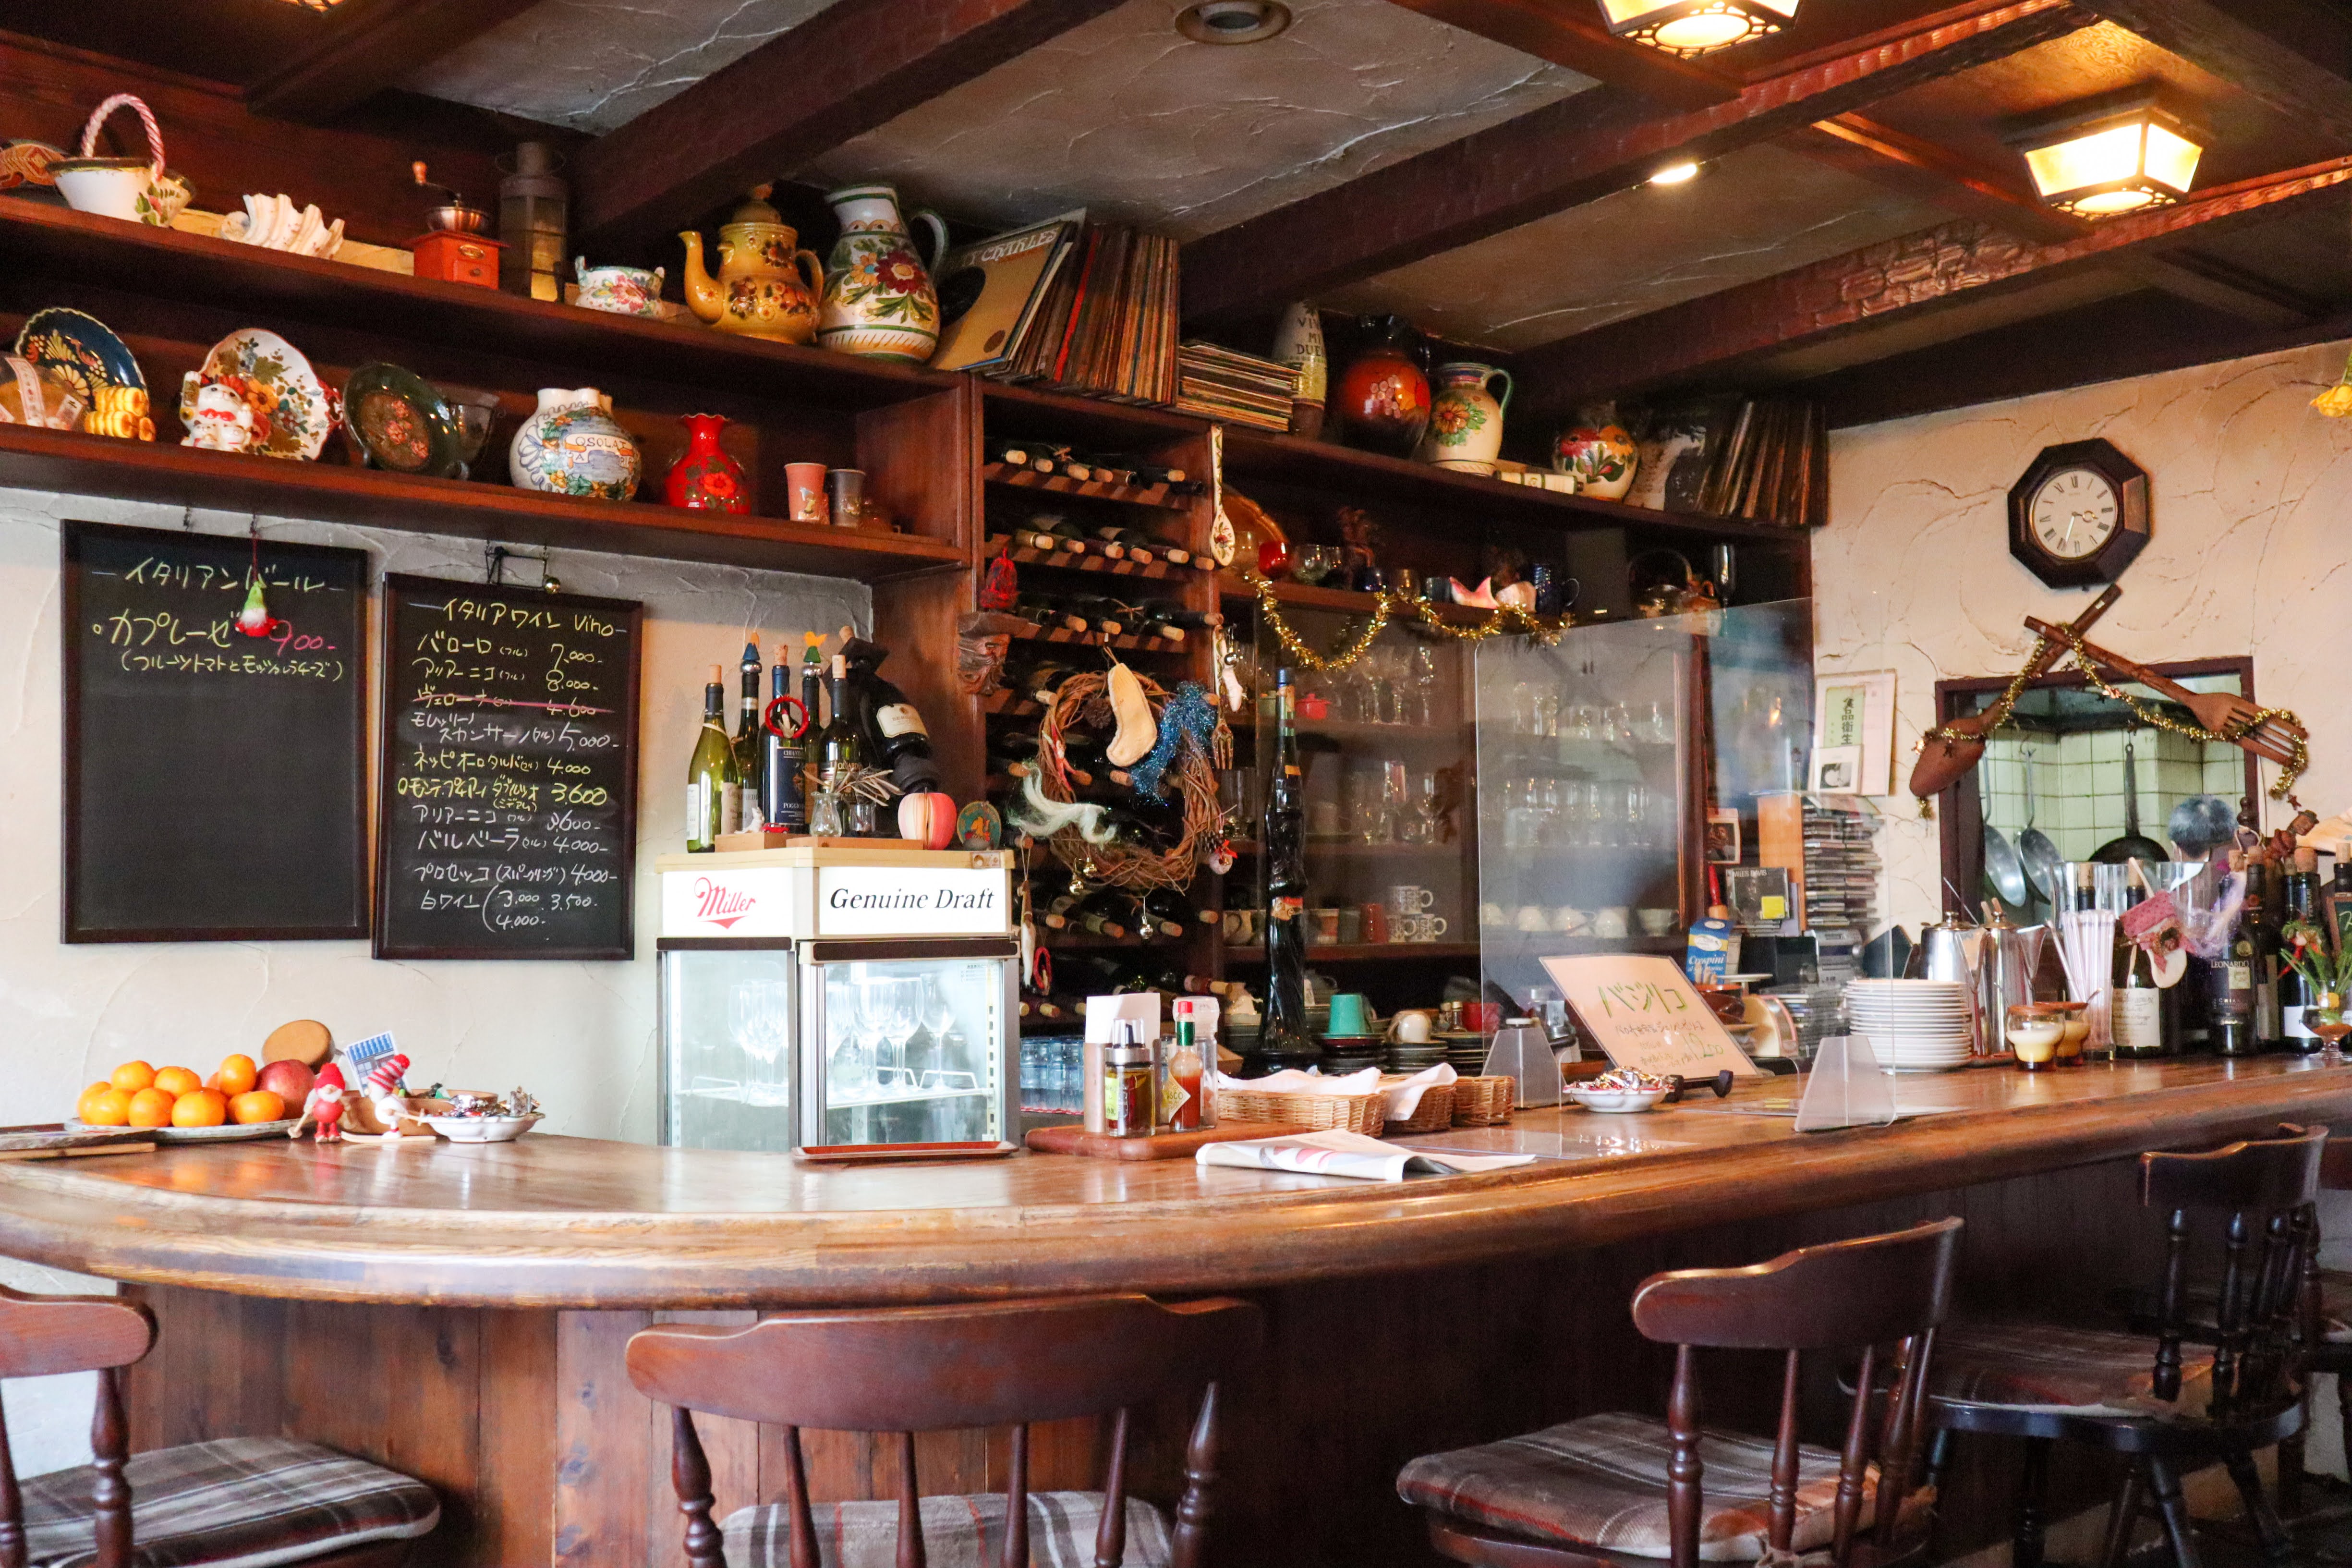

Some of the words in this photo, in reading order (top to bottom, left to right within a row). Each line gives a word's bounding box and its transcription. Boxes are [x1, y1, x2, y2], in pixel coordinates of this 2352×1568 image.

[694, 876, 756, 917] Miller
[830, 887, 929, 909] Genuine
[935, 887, 995, 909] Draft
